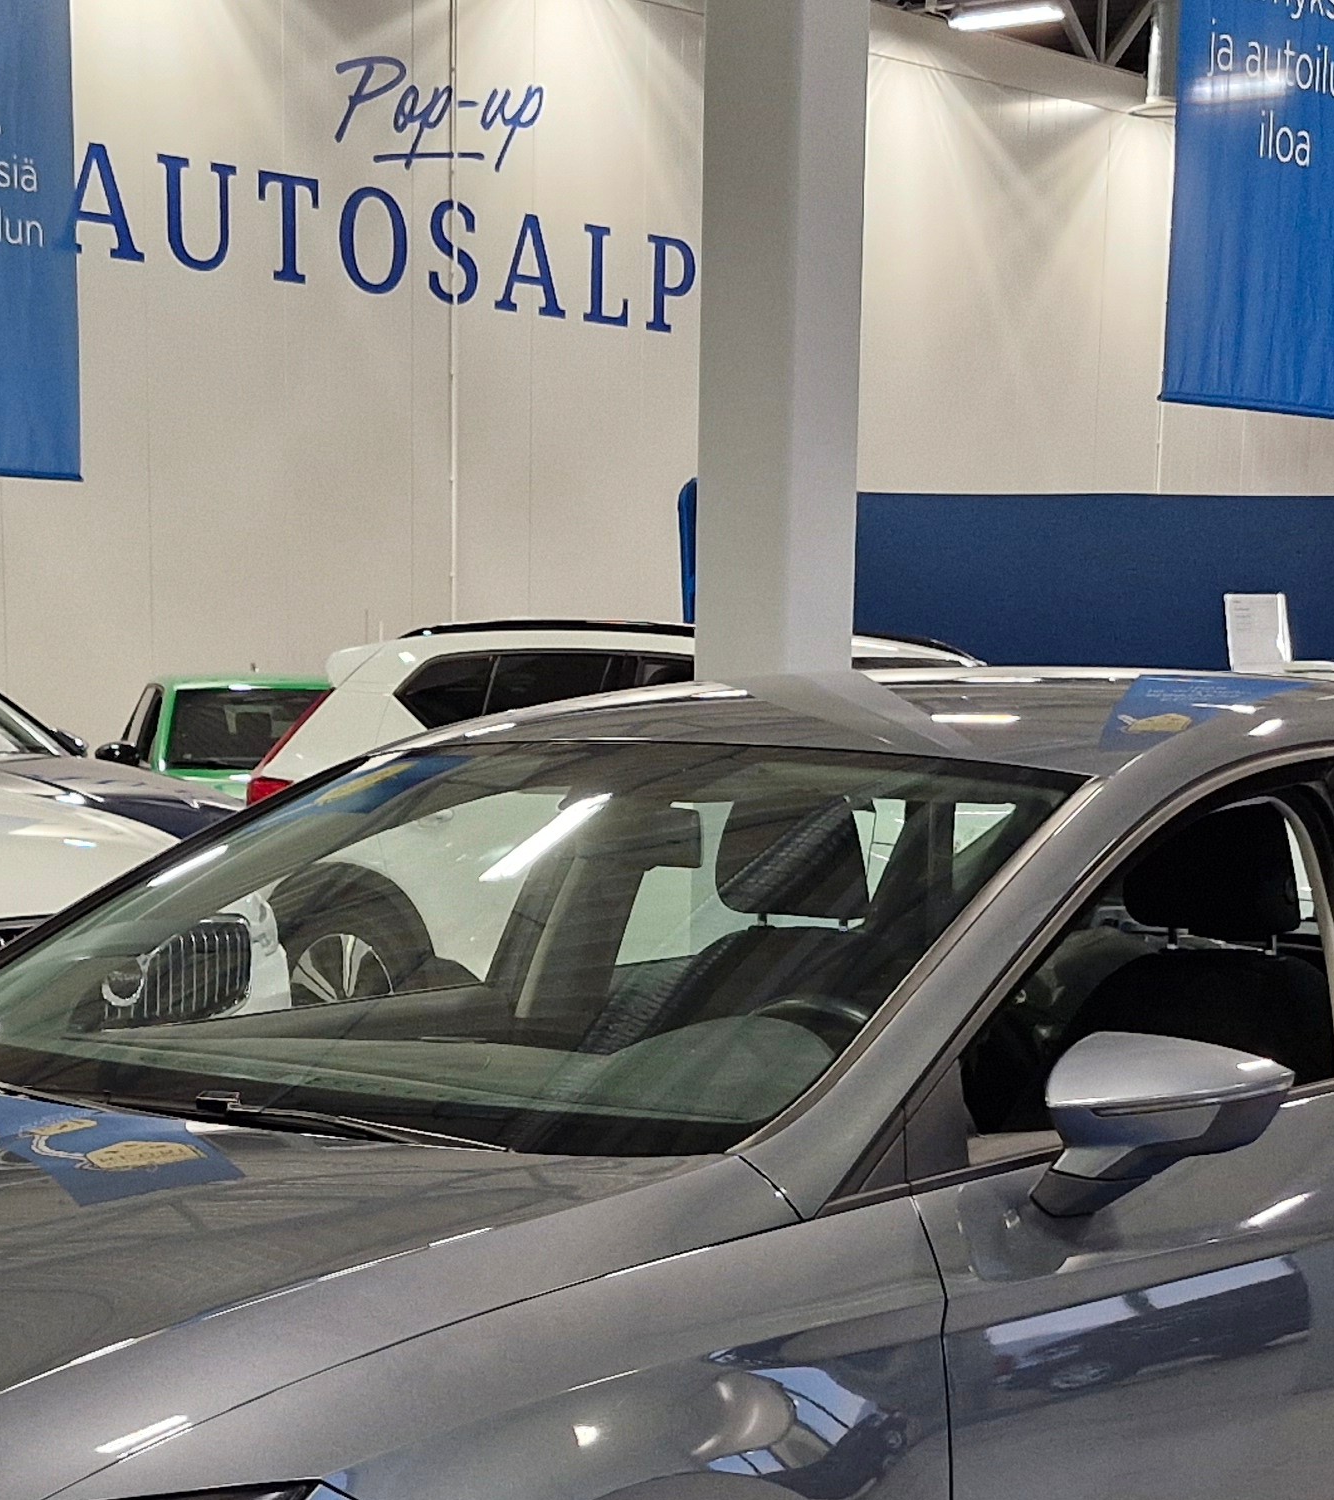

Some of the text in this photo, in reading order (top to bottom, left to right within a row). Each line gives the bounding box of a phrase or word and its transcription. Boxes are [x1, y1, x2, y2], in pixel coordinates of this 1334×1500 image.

[1207, 17, 1234, 77] ja
[334, 54, 545, 172] Pop-up
[1259, 110, 1311, 167] iloa
[74, 141, 697, 334] AUTOSALP
